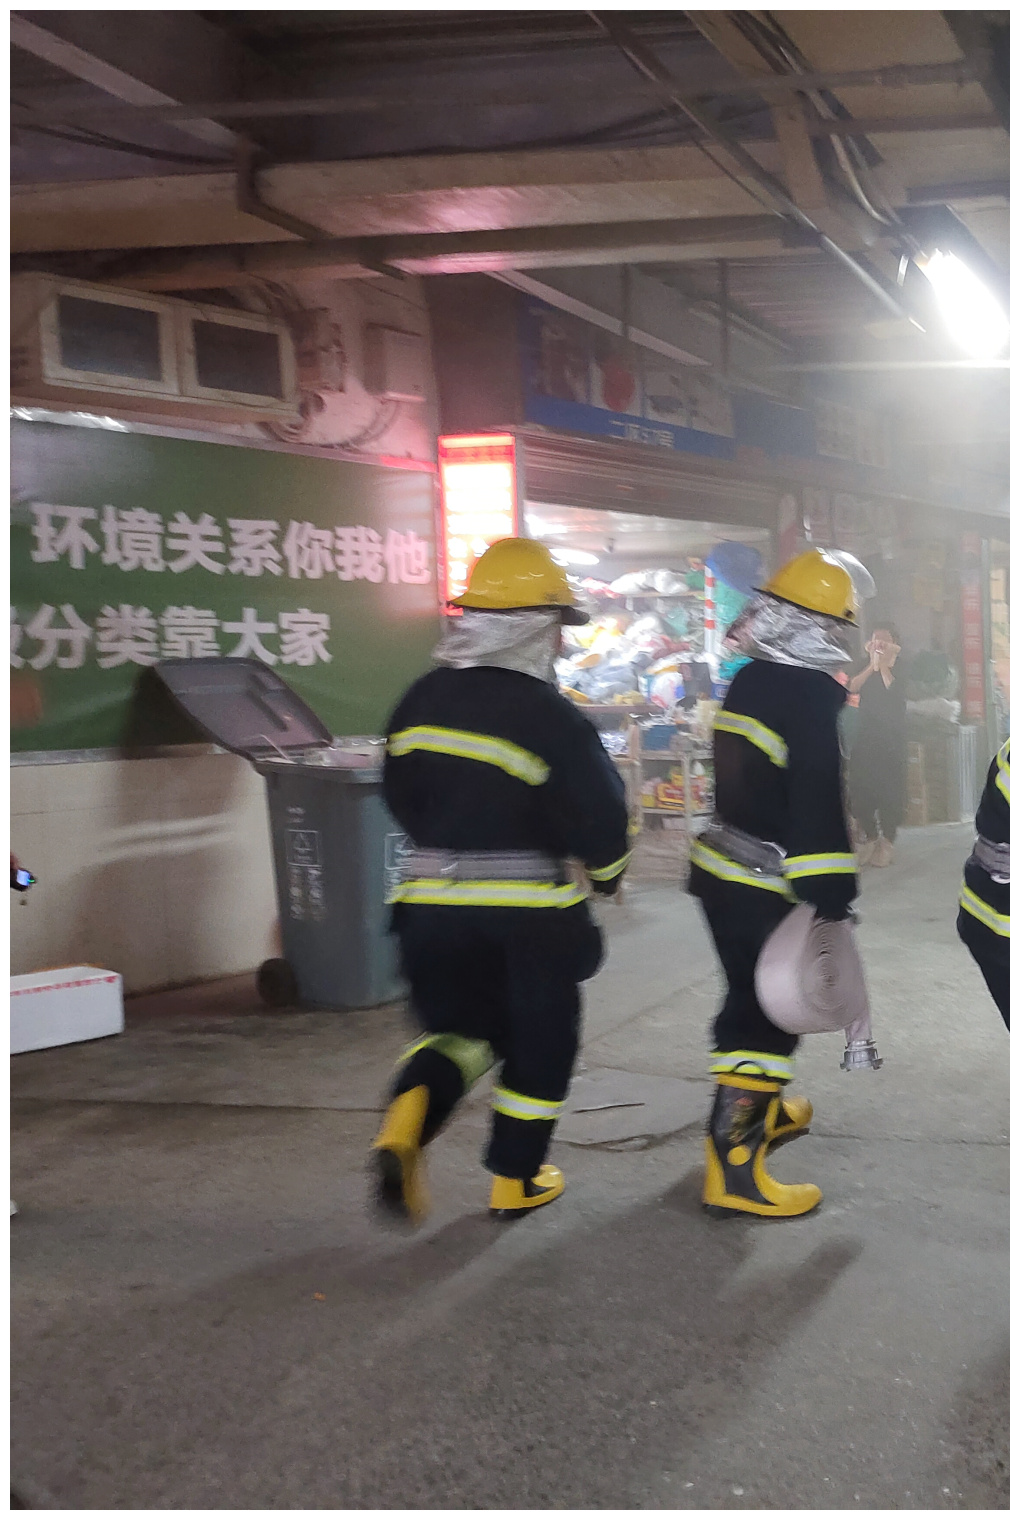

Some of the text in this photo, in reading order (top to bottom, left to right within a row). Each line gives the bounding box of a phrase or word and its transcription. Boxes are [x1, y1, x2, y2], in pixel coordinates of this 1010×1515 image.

[31, 502, 432, 586] 环境关系你我他
